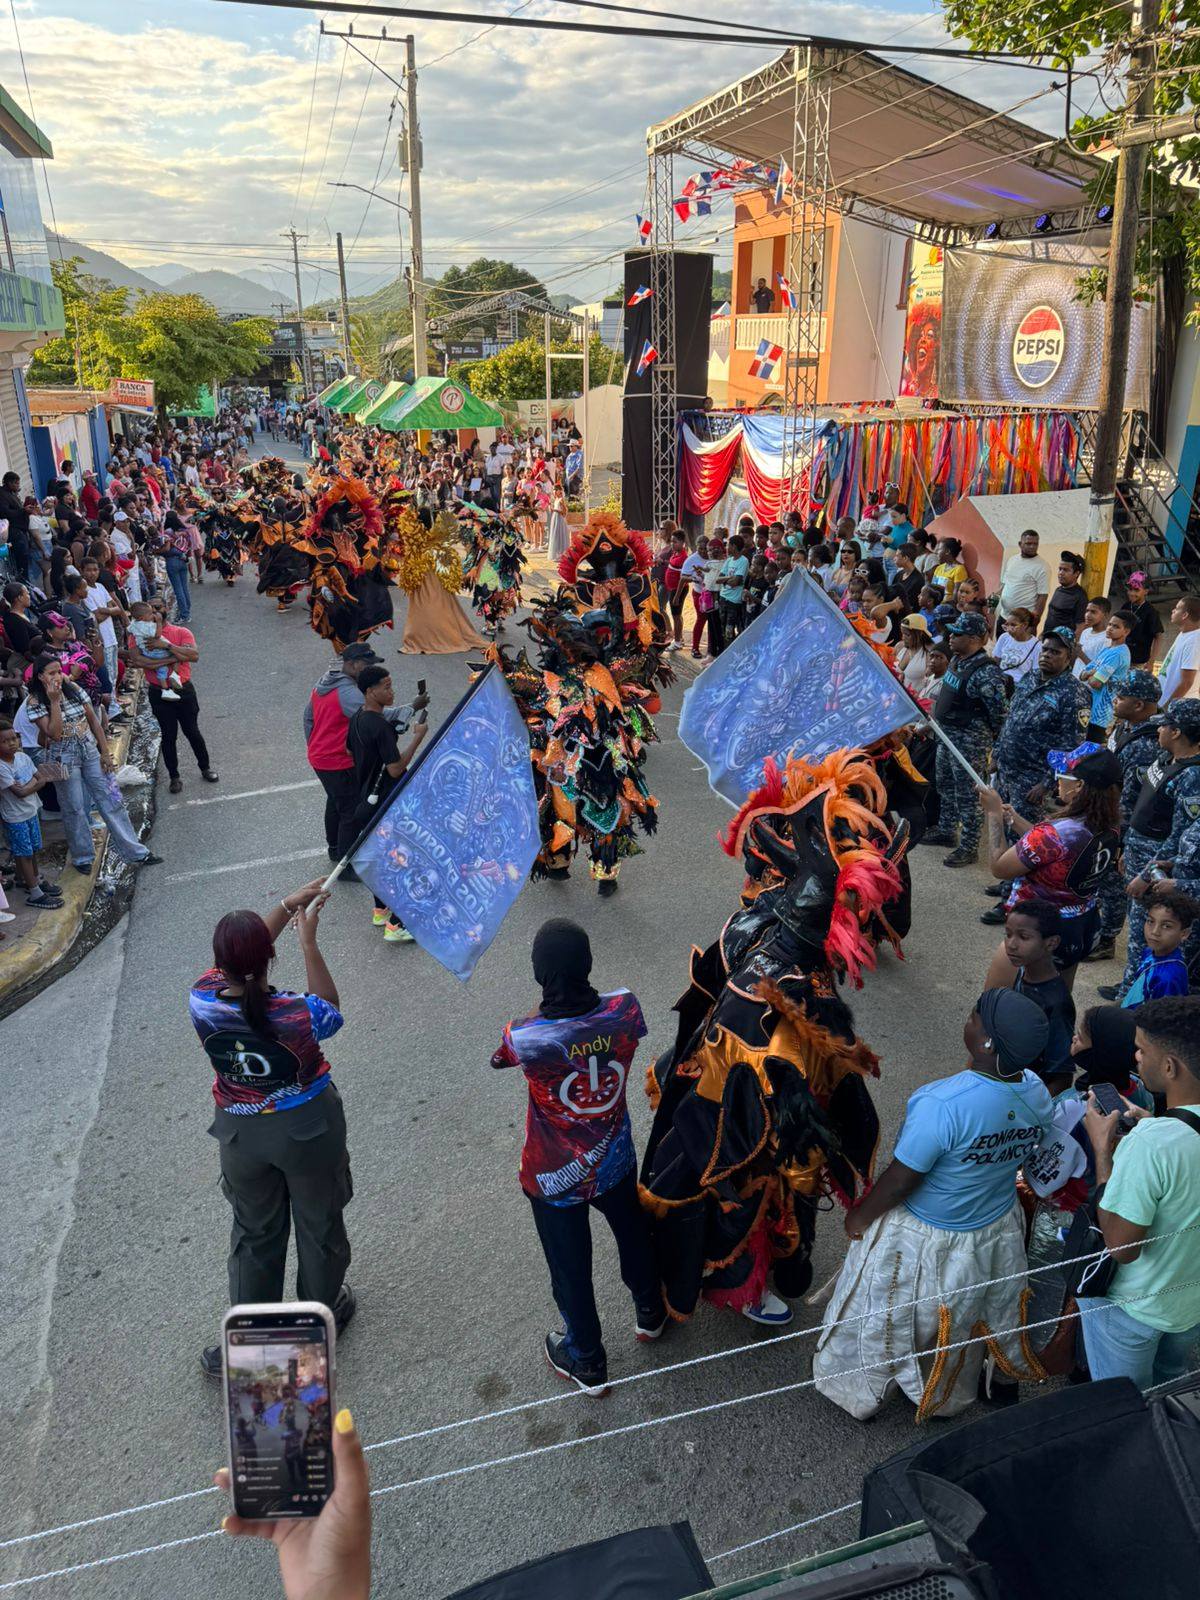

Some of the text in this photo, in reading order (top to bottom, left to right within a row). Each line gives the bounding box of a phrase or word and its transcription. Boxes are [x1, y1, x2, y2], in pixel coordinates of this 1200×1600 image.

[1017, 339, 1061, 355] PEPSI
[119, 382, 146, 391] BANCA
[1028, 850, 1041, 865] 12
[567, 1035, 612, 1060] Andy
[961, 1141, 1035, 1166] POLANCO
